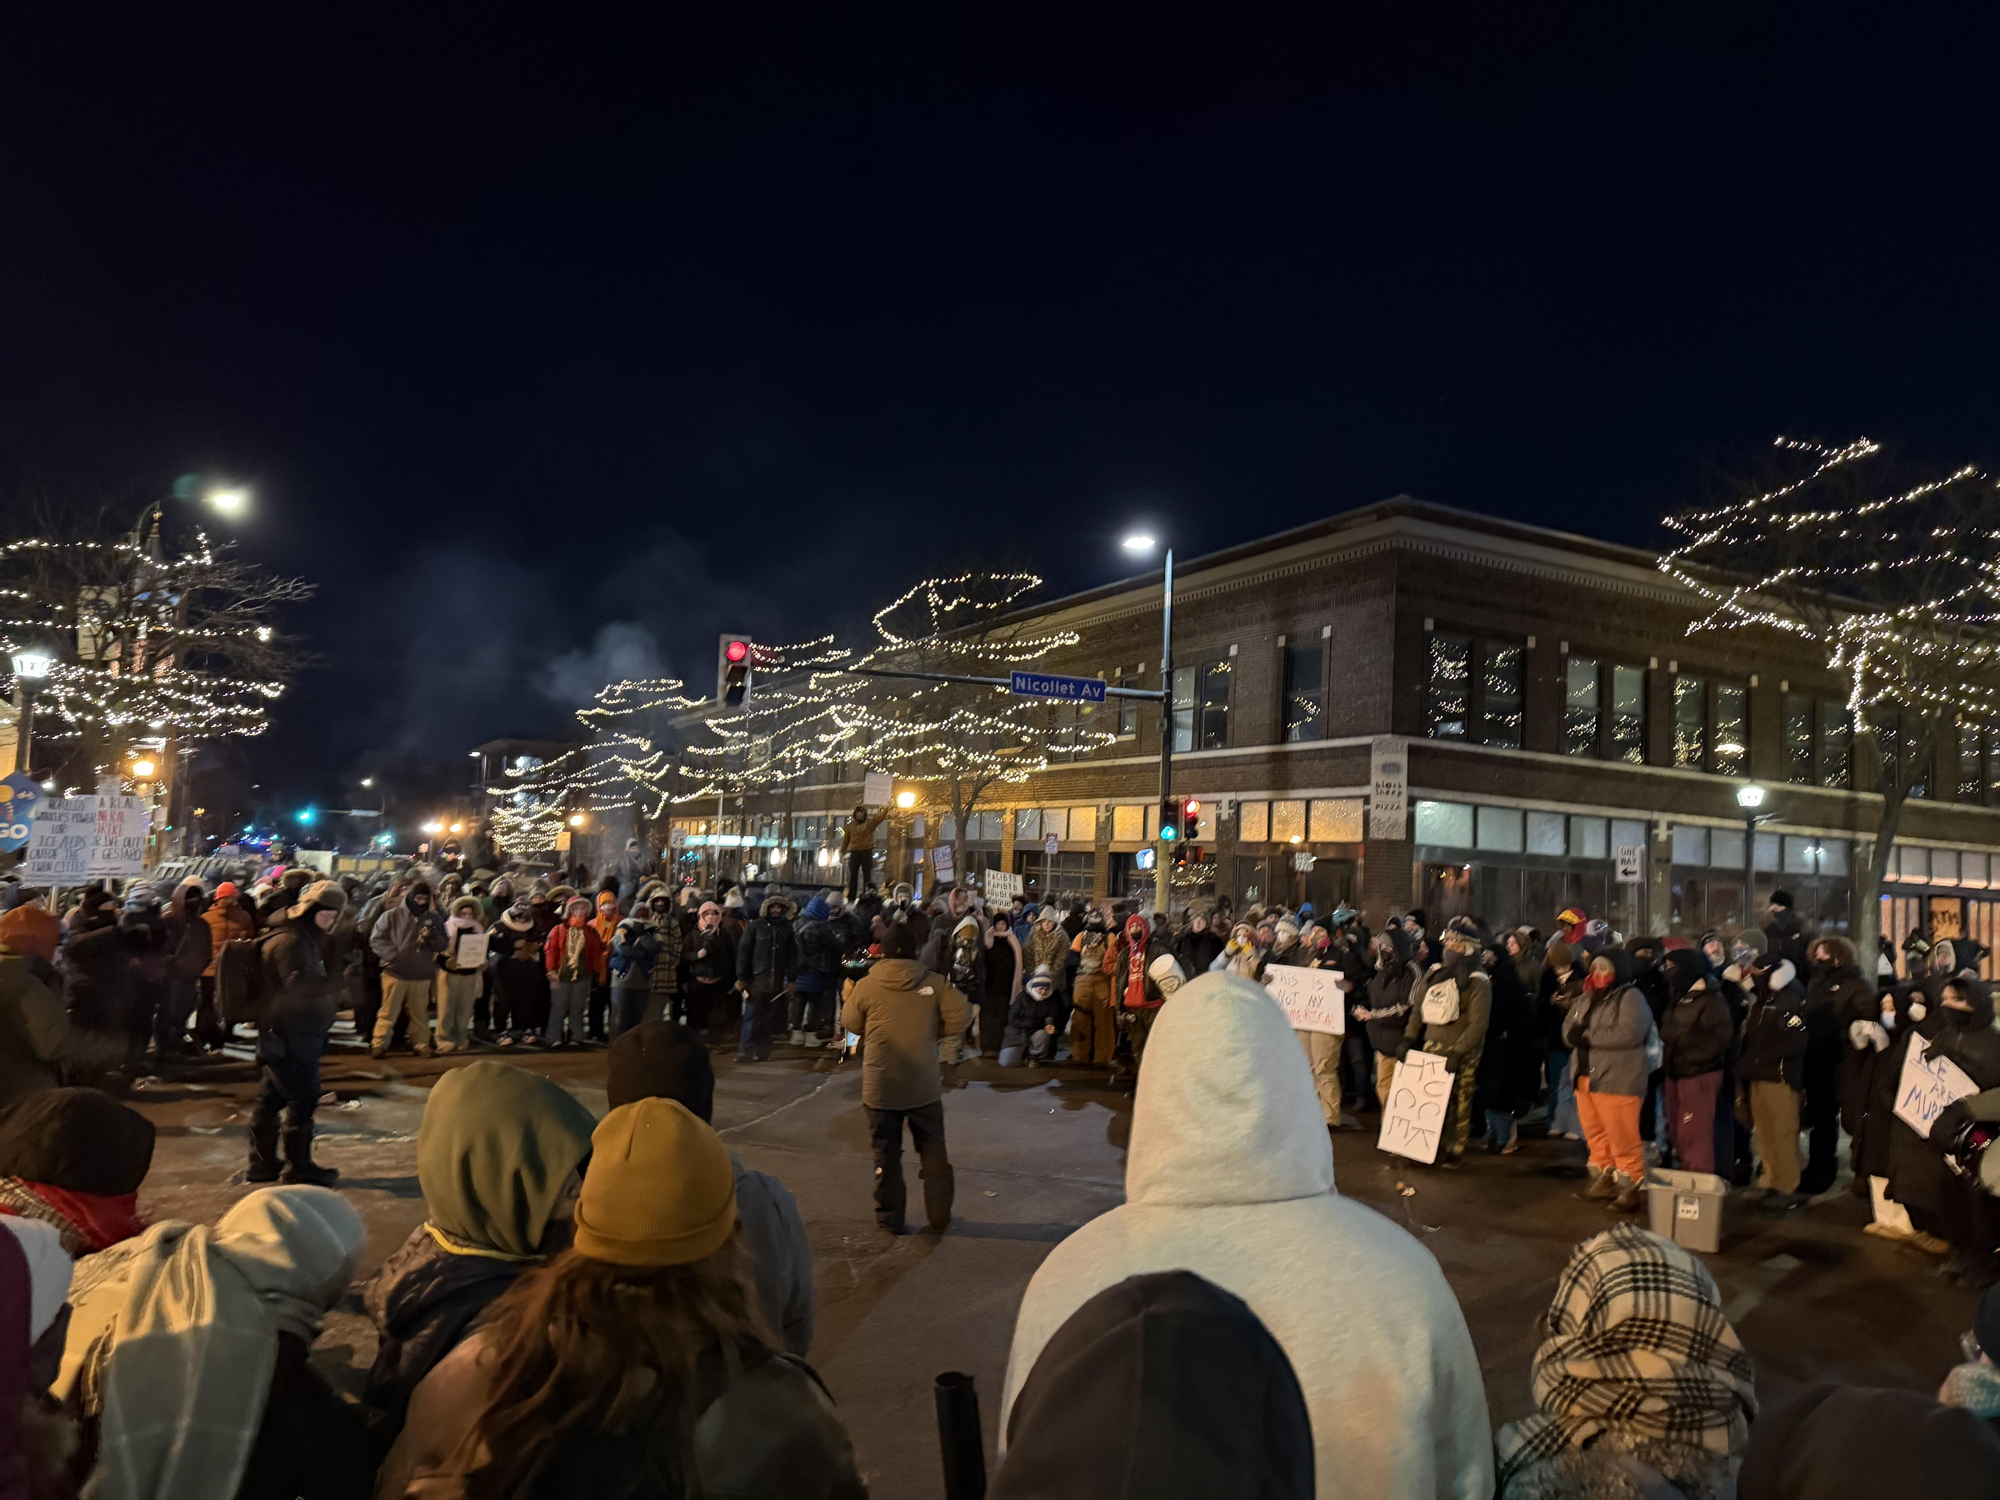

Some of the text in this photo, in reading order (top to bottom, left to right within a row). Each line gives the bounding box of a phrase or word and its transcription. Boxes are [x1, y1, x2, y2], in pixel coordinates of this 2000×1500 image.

[1015, 676, 1101, 698] Nicollet Av
[1375, 780, 1402, 789] black
[1375, 803, 1401, 811] PIZZA
[71, 812, 96, 823] POWER
[97, 810, 125, 823] NERAL
[123, 836, 142, 848] OUT
[102, 847, 142, 862] GESTAPO
[1620, 846, 1636, 856] ONE
[54, 861, 86, 873] CITIES
[1620, 856, 1637, 866] WAY
[1278, 989, 1325, 1008] NOT MY
[1288, 1008, 1336, 1030] MERICA!
